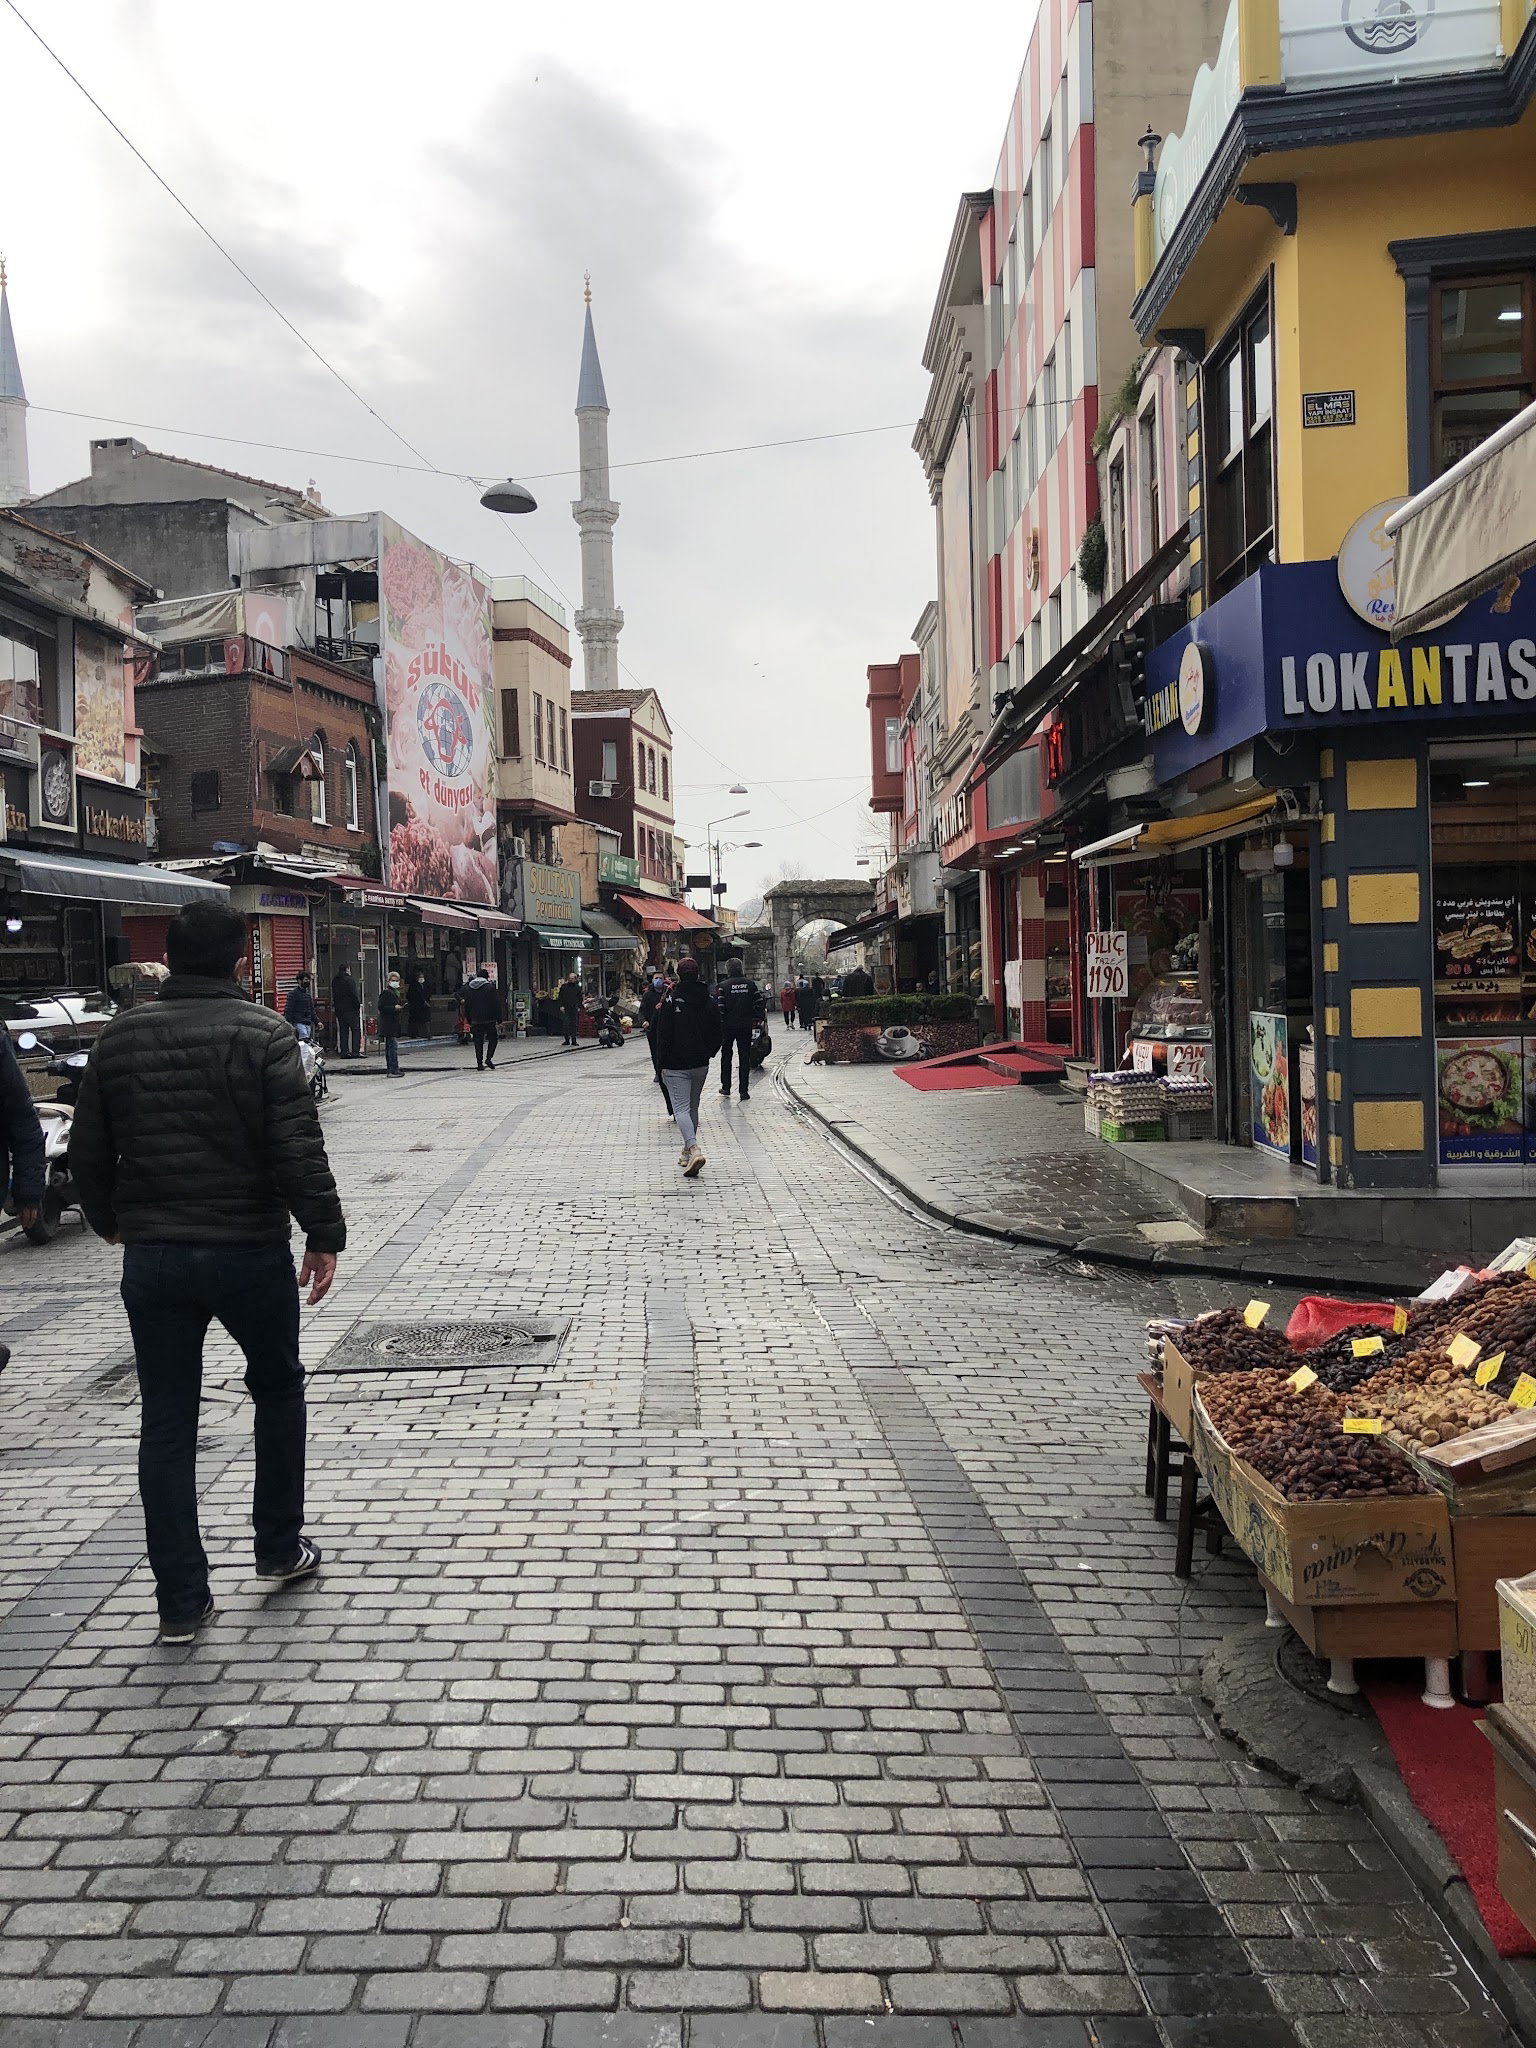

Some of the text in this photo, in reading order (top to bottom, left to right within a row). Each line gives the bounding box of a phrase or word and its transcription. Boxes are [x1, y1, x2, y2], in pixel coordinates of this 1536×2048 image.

[1281, 638, 1536, 715] LOKANTAS
[530, 866, 575, 900] SULTAN
[1446, 1149, 1475, 1160] الغربية
[1476, 1152, 1482, 1160] و
[1484, 1148, 1520, 1159] الشرقية
